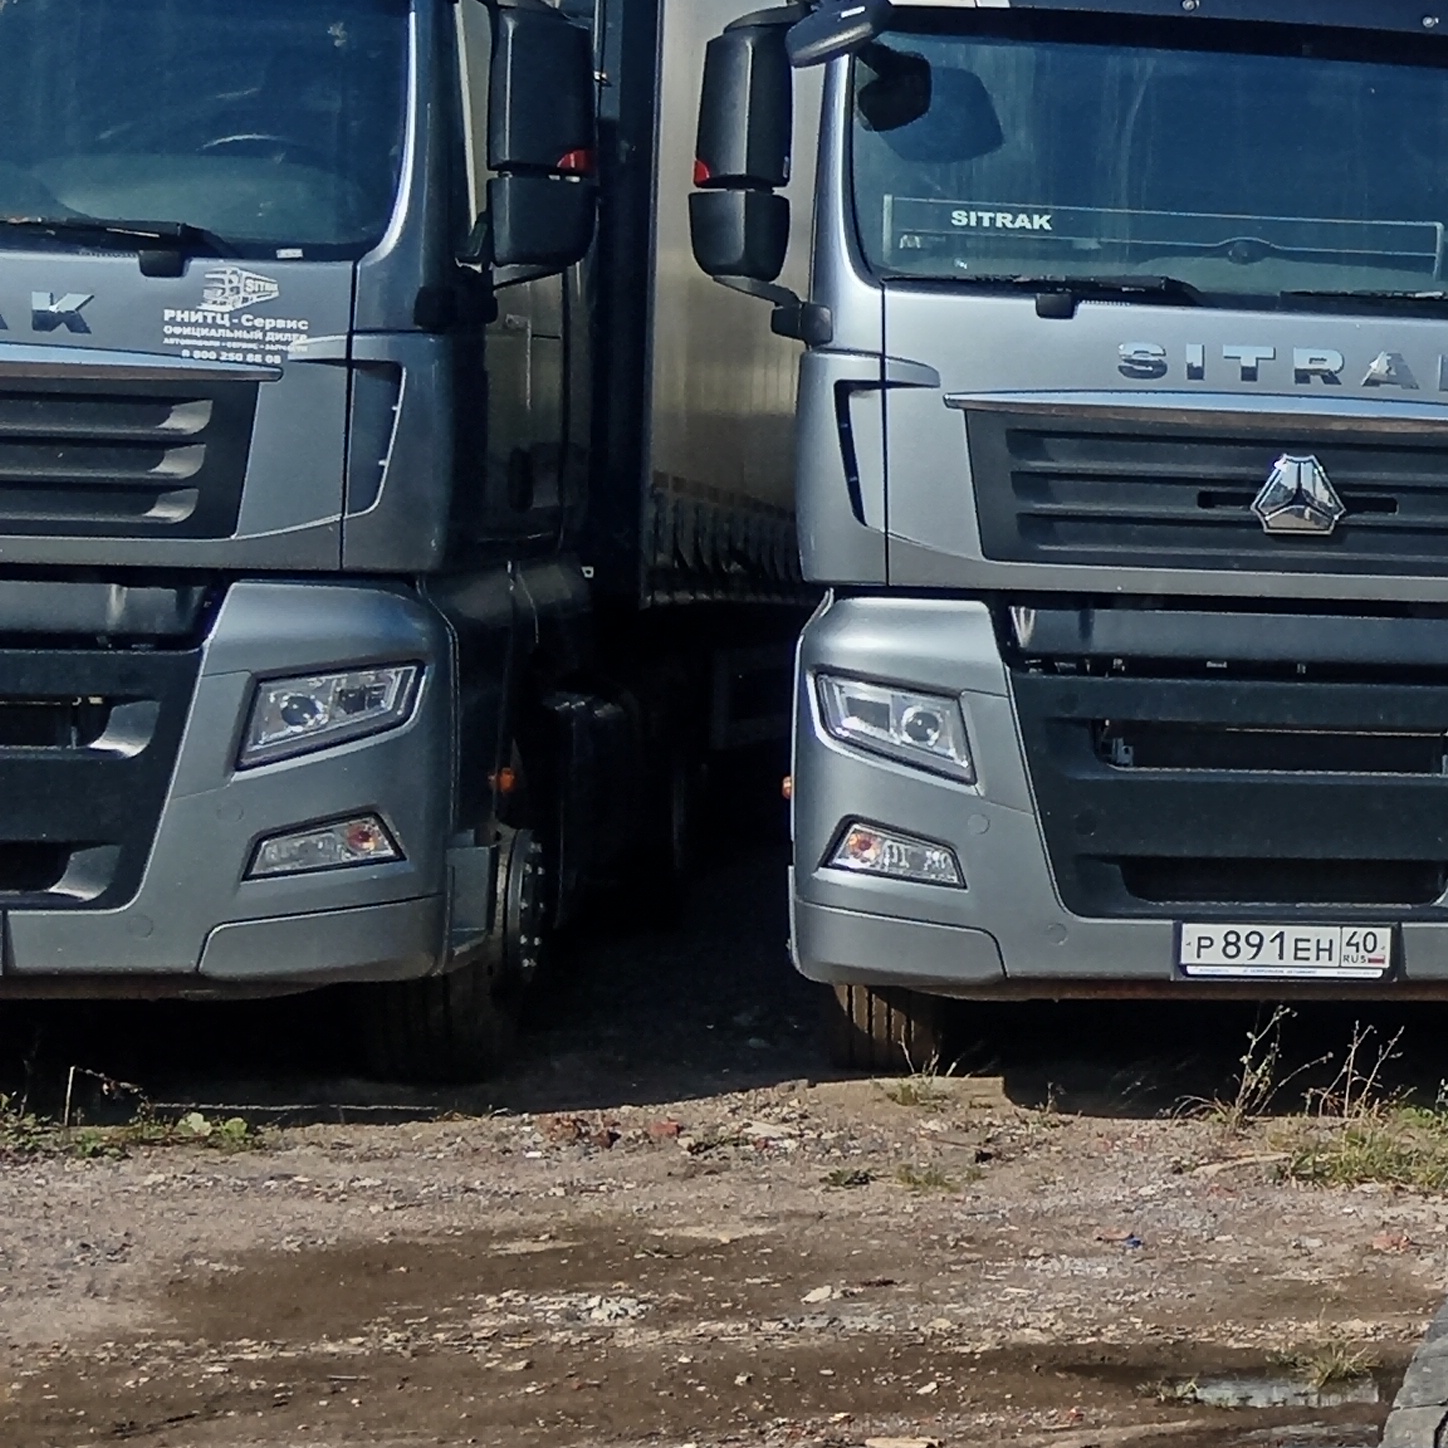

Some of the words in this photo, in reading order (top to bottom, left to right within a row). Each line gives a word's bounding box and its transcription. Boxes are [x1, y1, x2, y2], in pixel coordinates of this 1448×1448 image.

[951, 210, 1052, 230] SITRAK
[163, 325, 263, 340] ОФИЦИАЛЬНЫЙ
[1196, 929, 1333, 962] Р891ЕН
[1345, 931, 1378, 954] 40
[1343, 954, 1366, 964] RUS
